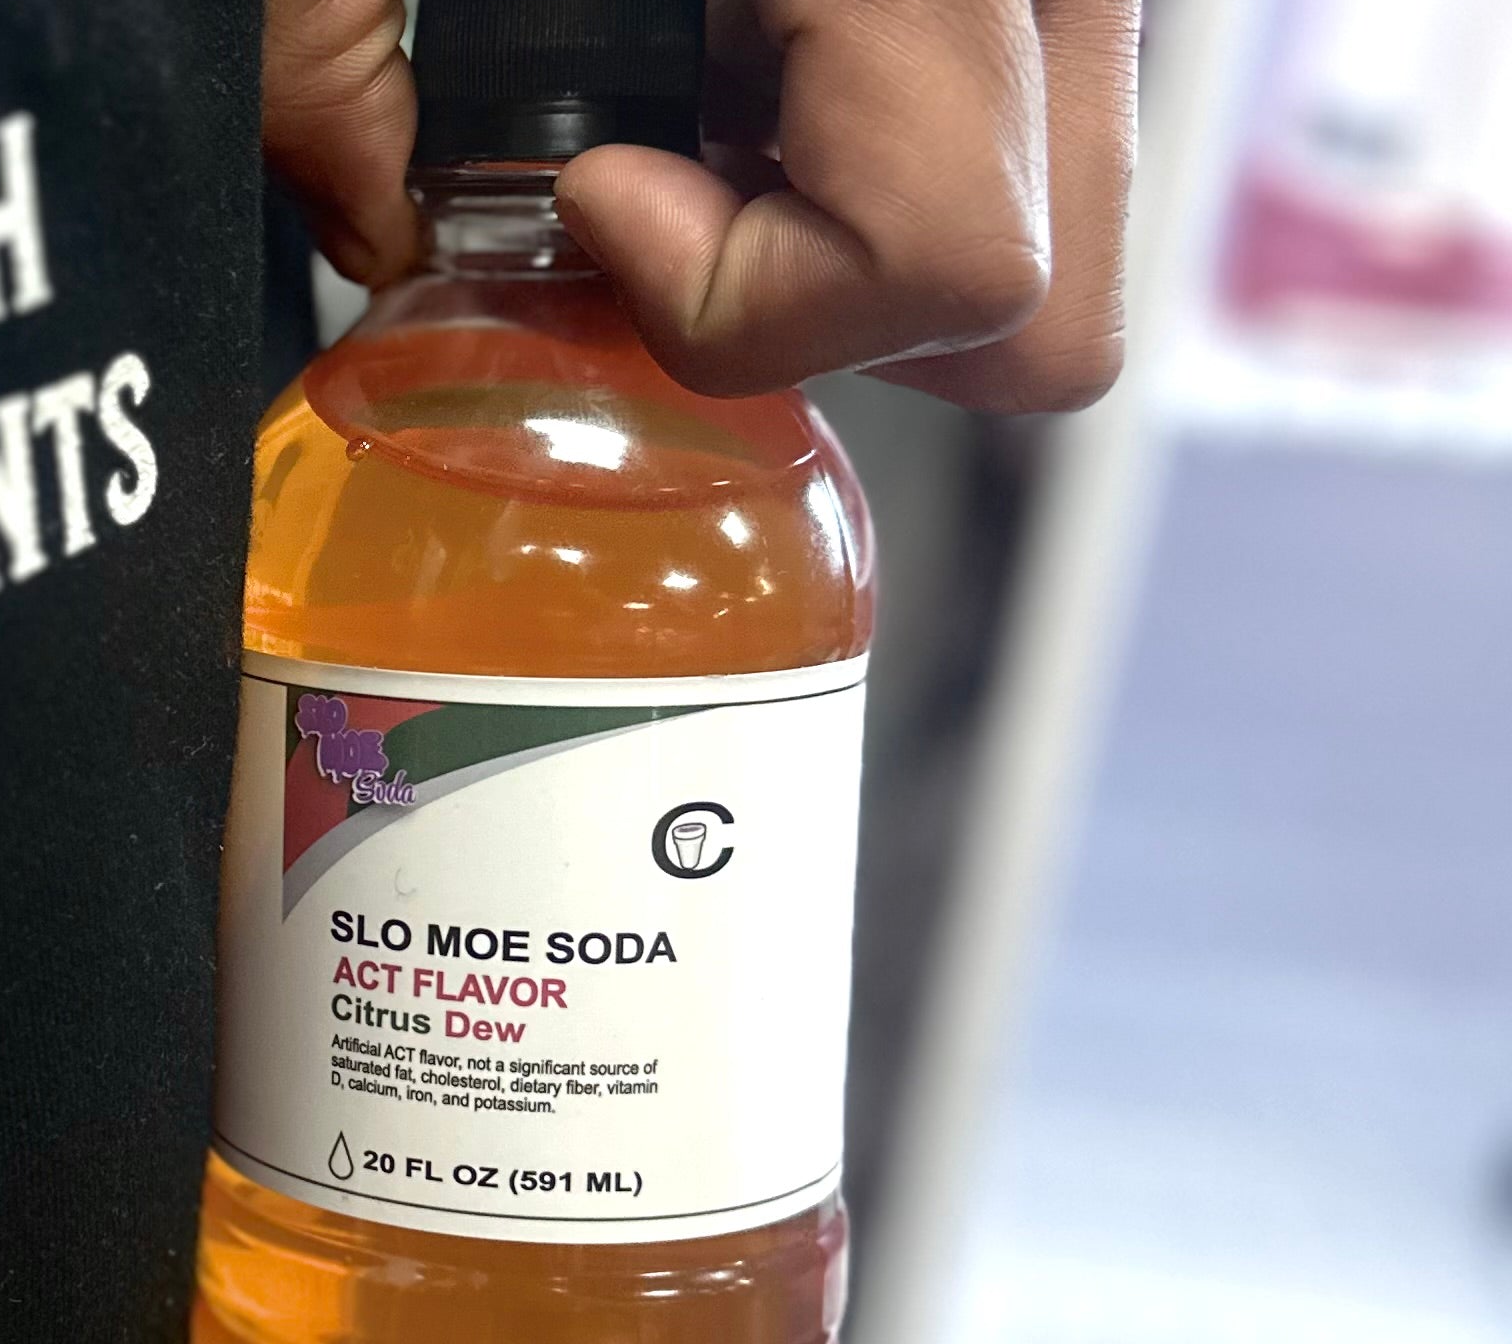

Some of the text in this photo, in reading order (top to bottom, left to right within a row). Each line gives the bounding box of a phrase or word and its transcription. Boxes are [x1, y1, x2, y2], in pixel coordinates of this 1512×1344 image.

[352, 769, 416, 806] Soda
[330, 909, 678, 965] SLO MOE SODA
[332, 956, 568, 1009] ACT FLAVOR
[331, 993, 526, 1044] Citrus Dew
[331, 1033, 659, 1077] Artificial ACT flavor, not a significant source of
[331, 1054, 658, 1098] saturated fat, cholesterol, dietary fiber, vitamin
[331, 1069, 557, 1114] D, calcium, iron, and potassium.
[362, 1149, 643, 1198] 20 FL OZ (591 ML)
